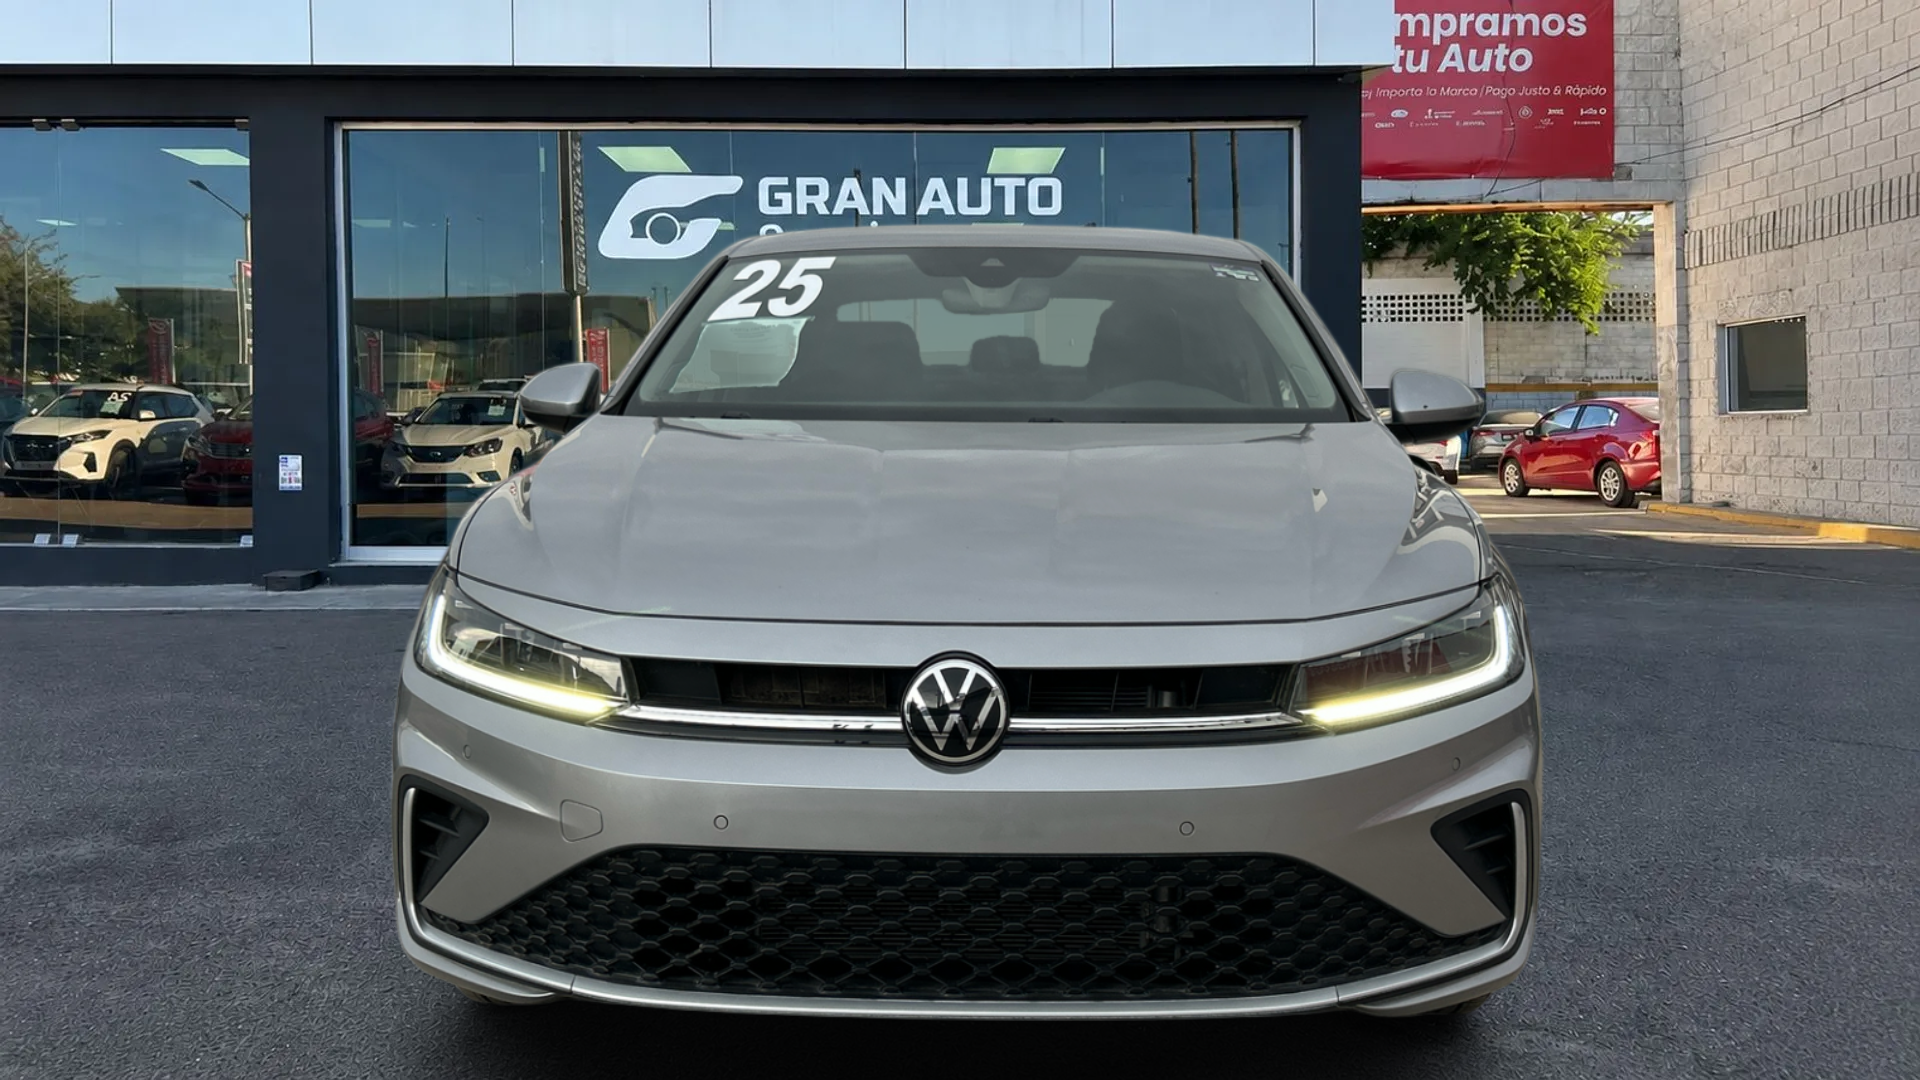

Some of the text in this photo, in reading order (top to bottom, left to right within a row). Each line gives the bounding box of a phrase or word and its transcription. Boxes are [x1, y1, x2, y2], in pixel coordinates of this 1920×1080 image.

[1392, 43, 1533, 73] tu Auto
[1376, 87, 1423, 99] Importa
[1426, 86, 1437, 96] la
[1439, 86, 1478, 97] Marca
[1518, 85, 1551, 96] Justo
[1553, 86, 1562, 96] &
[1565, 84, 1607, 98] Rápido
[758, 177, 1063, 215] GRAN AUTO
[707, 256, 837, 322] 25
